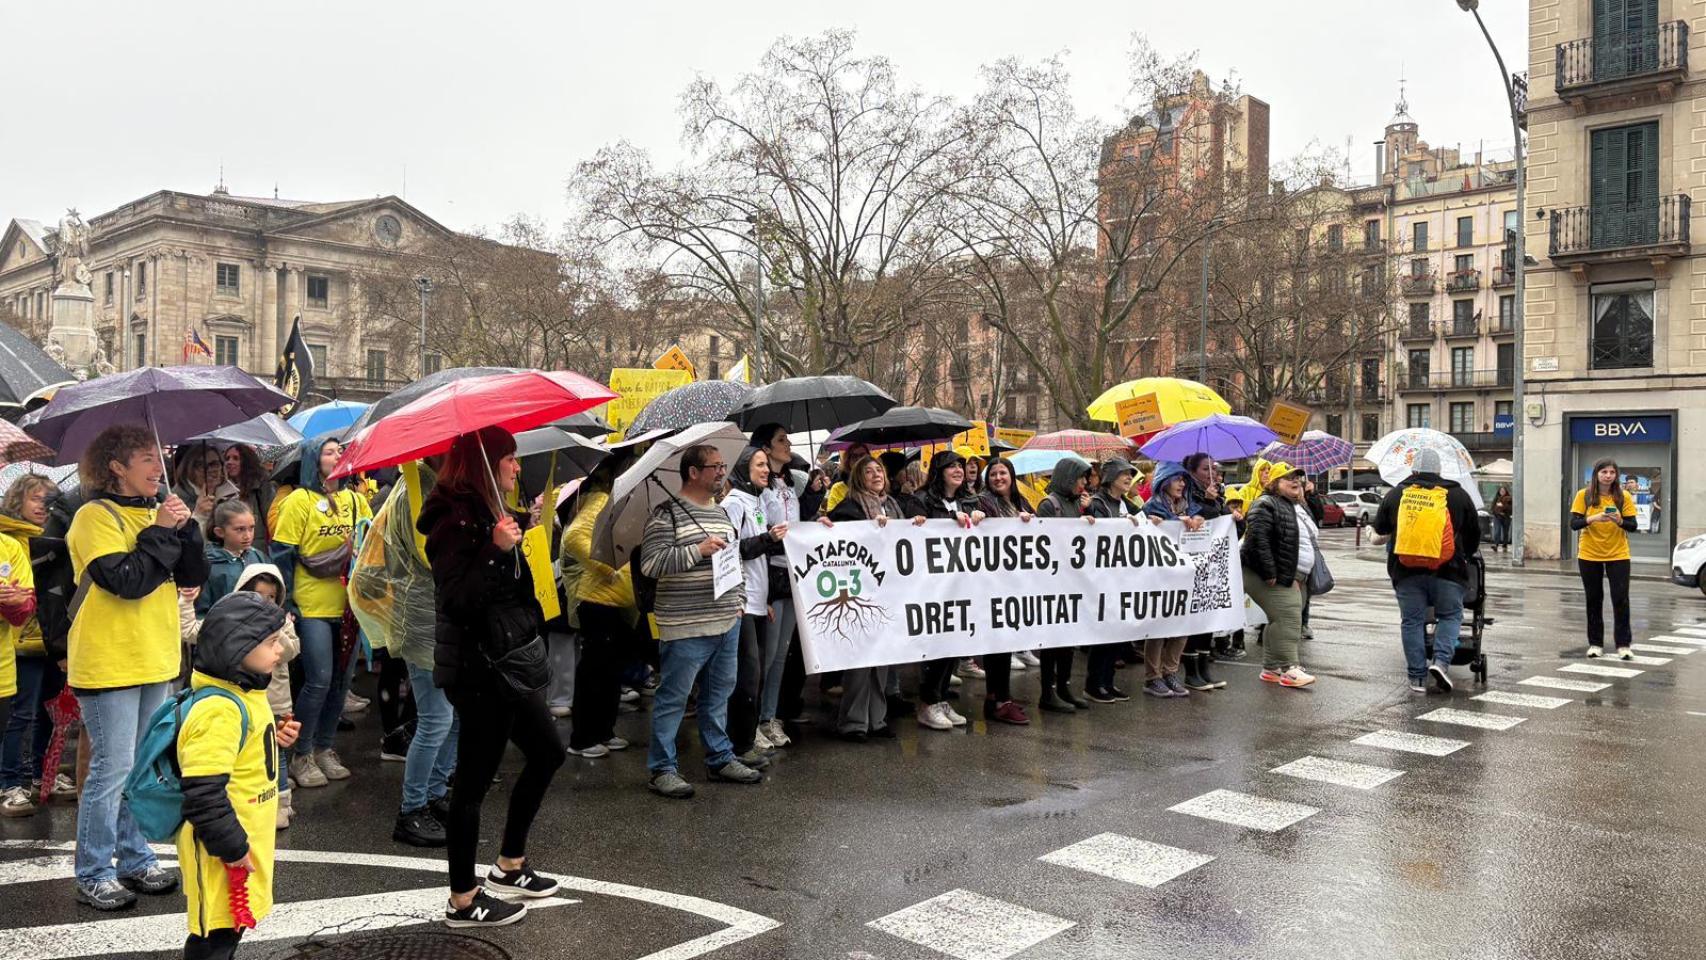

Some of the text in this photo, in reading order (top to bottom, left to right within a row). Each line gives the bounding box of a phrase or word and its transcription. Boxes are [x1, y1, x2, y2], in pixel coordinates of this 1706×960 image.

[1595, 421, 1647, 436] BBVA
[895, 538, 914, 576] 0
[925, 534, 1059, 575] EXCUSES,
[1070, 535, 1086, 569] 3
[816, 568, 862, 598] 0-3
[904, 589, 1188, 637] DRET, EQUITAT I FUTUR
